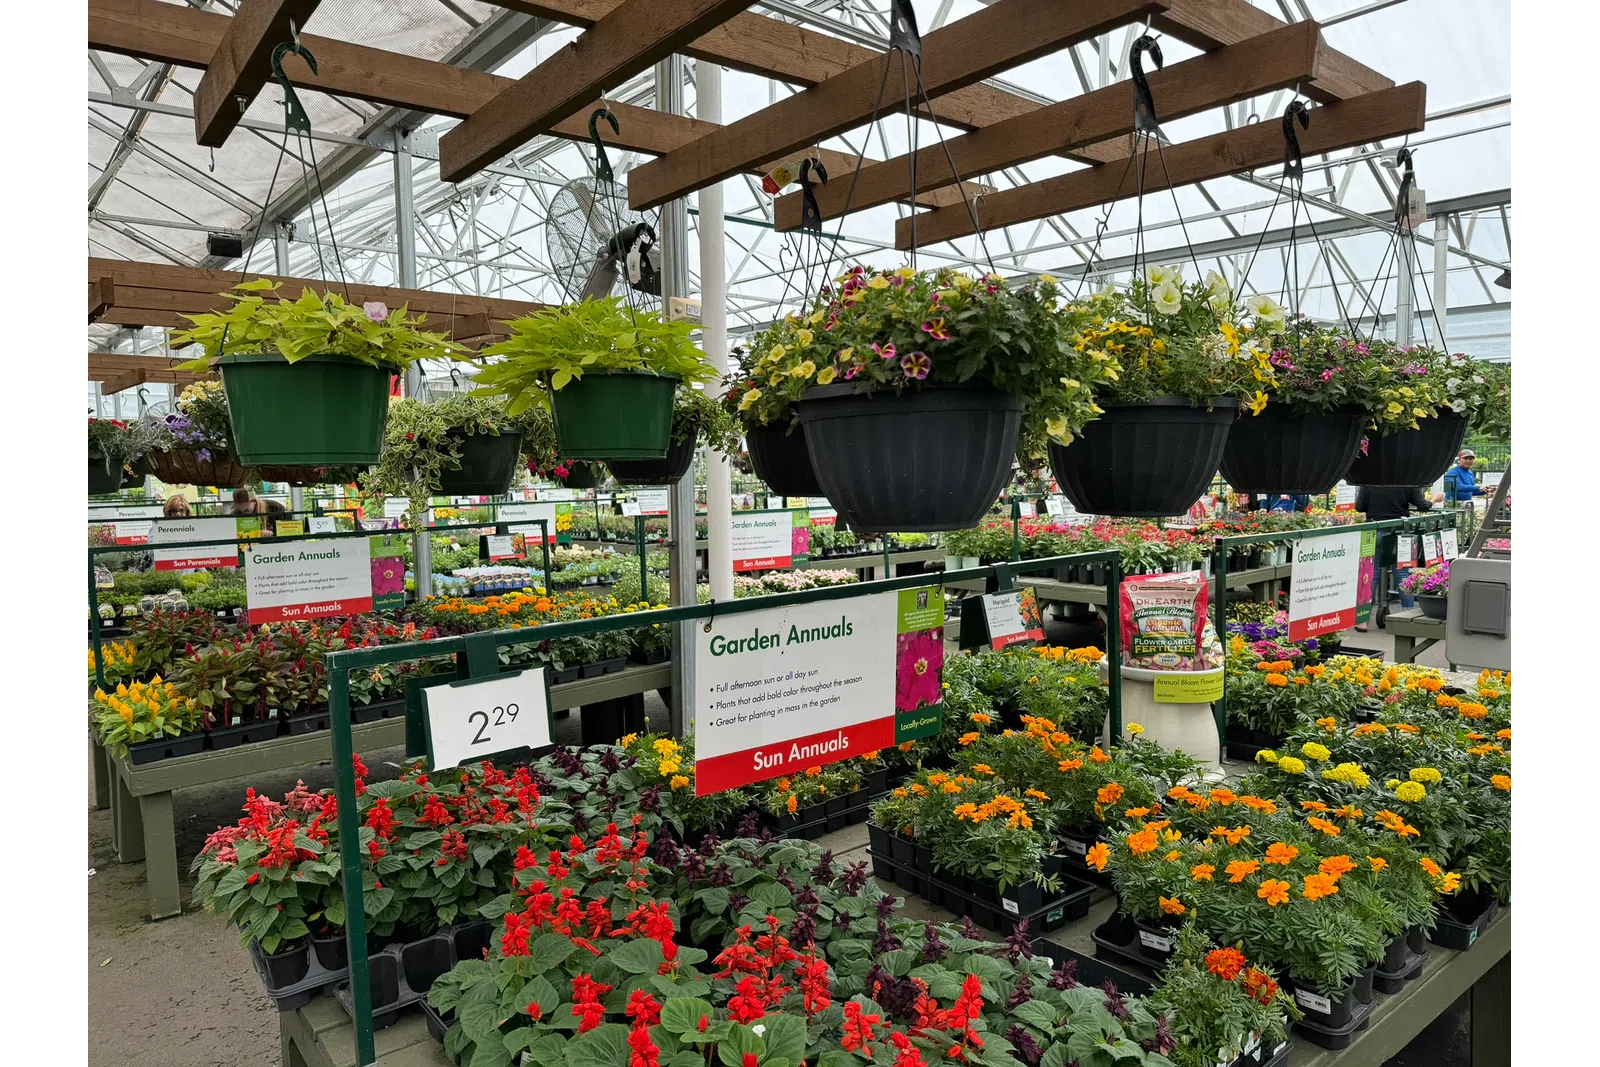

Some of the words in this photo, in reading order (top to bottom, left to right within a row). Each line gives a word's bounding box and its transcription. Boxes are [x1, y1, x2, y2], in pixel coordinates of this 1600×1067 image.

[158, 525, 195, 533] Perennials
[253, 552, 294, 564] Garden
[298, 548, 340, 561] Annuals
[1298, 548, 1320, 563] Garden
[1322, 544, 1346, 559] Annuals
[755, 558, 775, 566] Annuals
[282, 606, 300, 616] Sun
[303, 601, 342, 614] Annuals
[993, 597, 1010, 605] Marigold
[1136, 608, 1165, 617] Annual
[1167, 608, 1192, 617] Bloom
[1147, 618, 1182, 626] Organic
[1307, 620, 1318, 631] Sun
[1319, 613, 1340, 628] Annuals
[710, 628, 780, 657] Garden
[786, 615, 853, 646] Annuals
[1135, 645, 1196, 653] FERTILIZER
[716, 682, 728, 693] Full
[730, 680, 762, 690] afternoon
[785, 671, 793, 680] all
[795, 670, 806, 679] day
[716, 700, 736, 710] Plants
[738, 697, 750, 705] that
[752, 692, 765, 703] add
[767, 689, 781, 700] bold
[783, 687, 799, 697] color
[800, 681, 832, 693] throughout
[833, 678, 842, 687] the
[844, 676, 862, 685] season
[716, 717, 736, 726] Great
[738, 713, 747, 722] for
[749, 710, 775, 722] planting
[785, 704, 800, 712] mass
[809, 699, 818, 707] the
[820, 694, 840, 707] garden
[900, 716, 937, 731] Locally-Grown
[753, 752, 783, 771] Sun
[788, 731, 848, 762] Annuals
